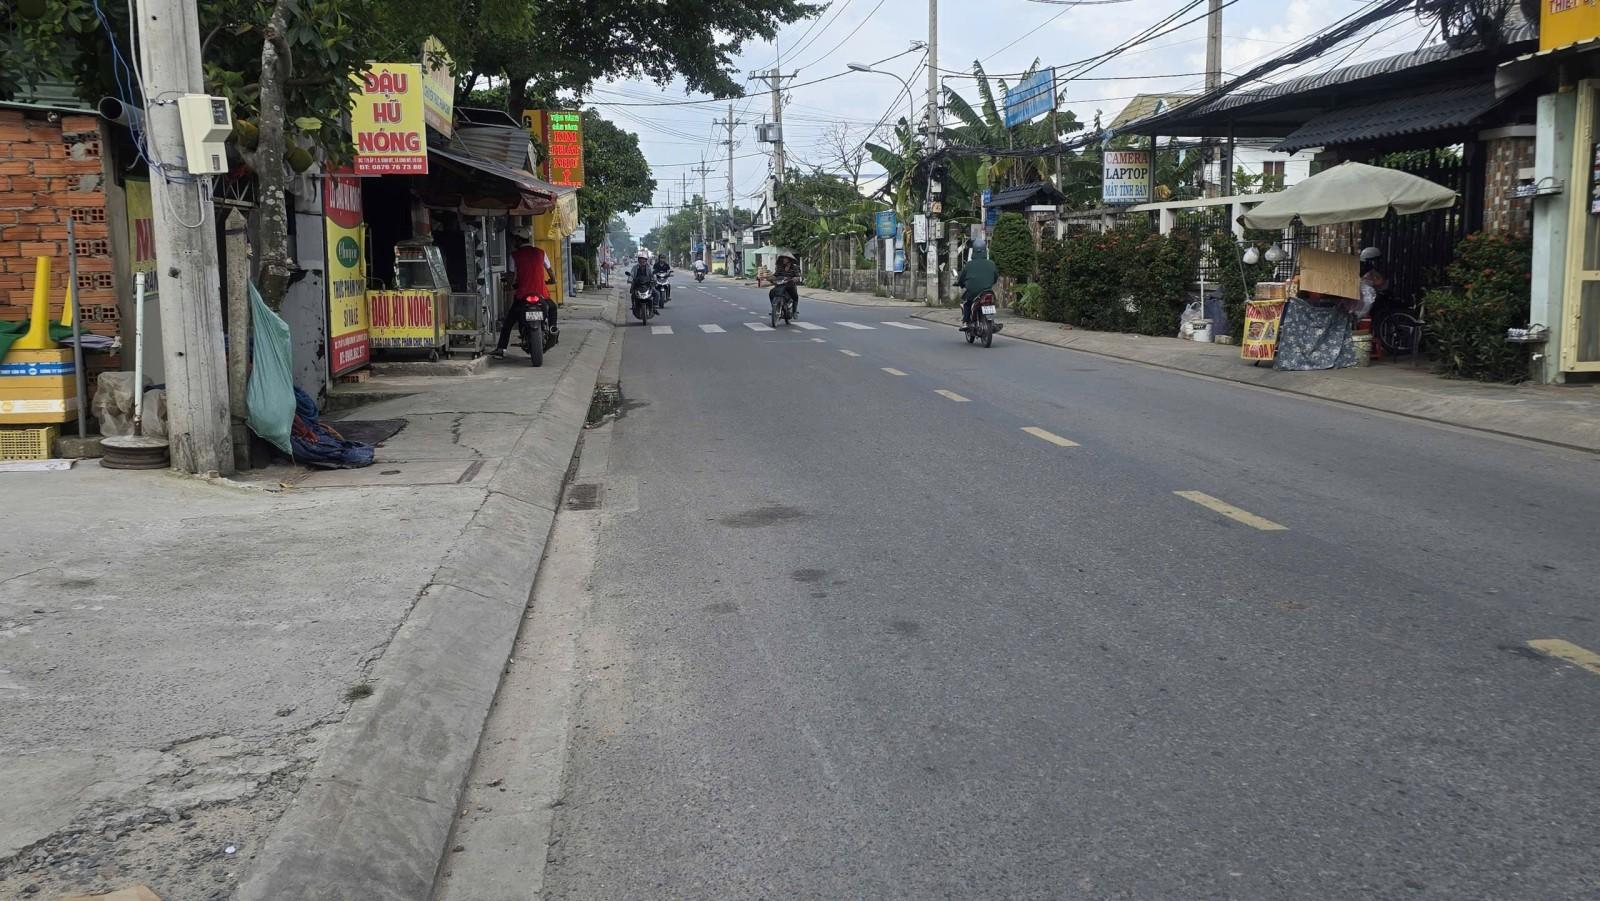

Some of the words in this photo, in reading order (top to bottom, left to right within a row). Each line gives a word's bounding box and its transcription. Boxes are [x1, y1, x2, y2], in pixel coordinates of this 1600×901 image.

[373, 99, 402, 123] HŨ
[358, 128, 421, 152] NÓNG
[1106, 152, 1149, 164] CAMERA
[1106, 167, 1148, 180] LAPTOP
